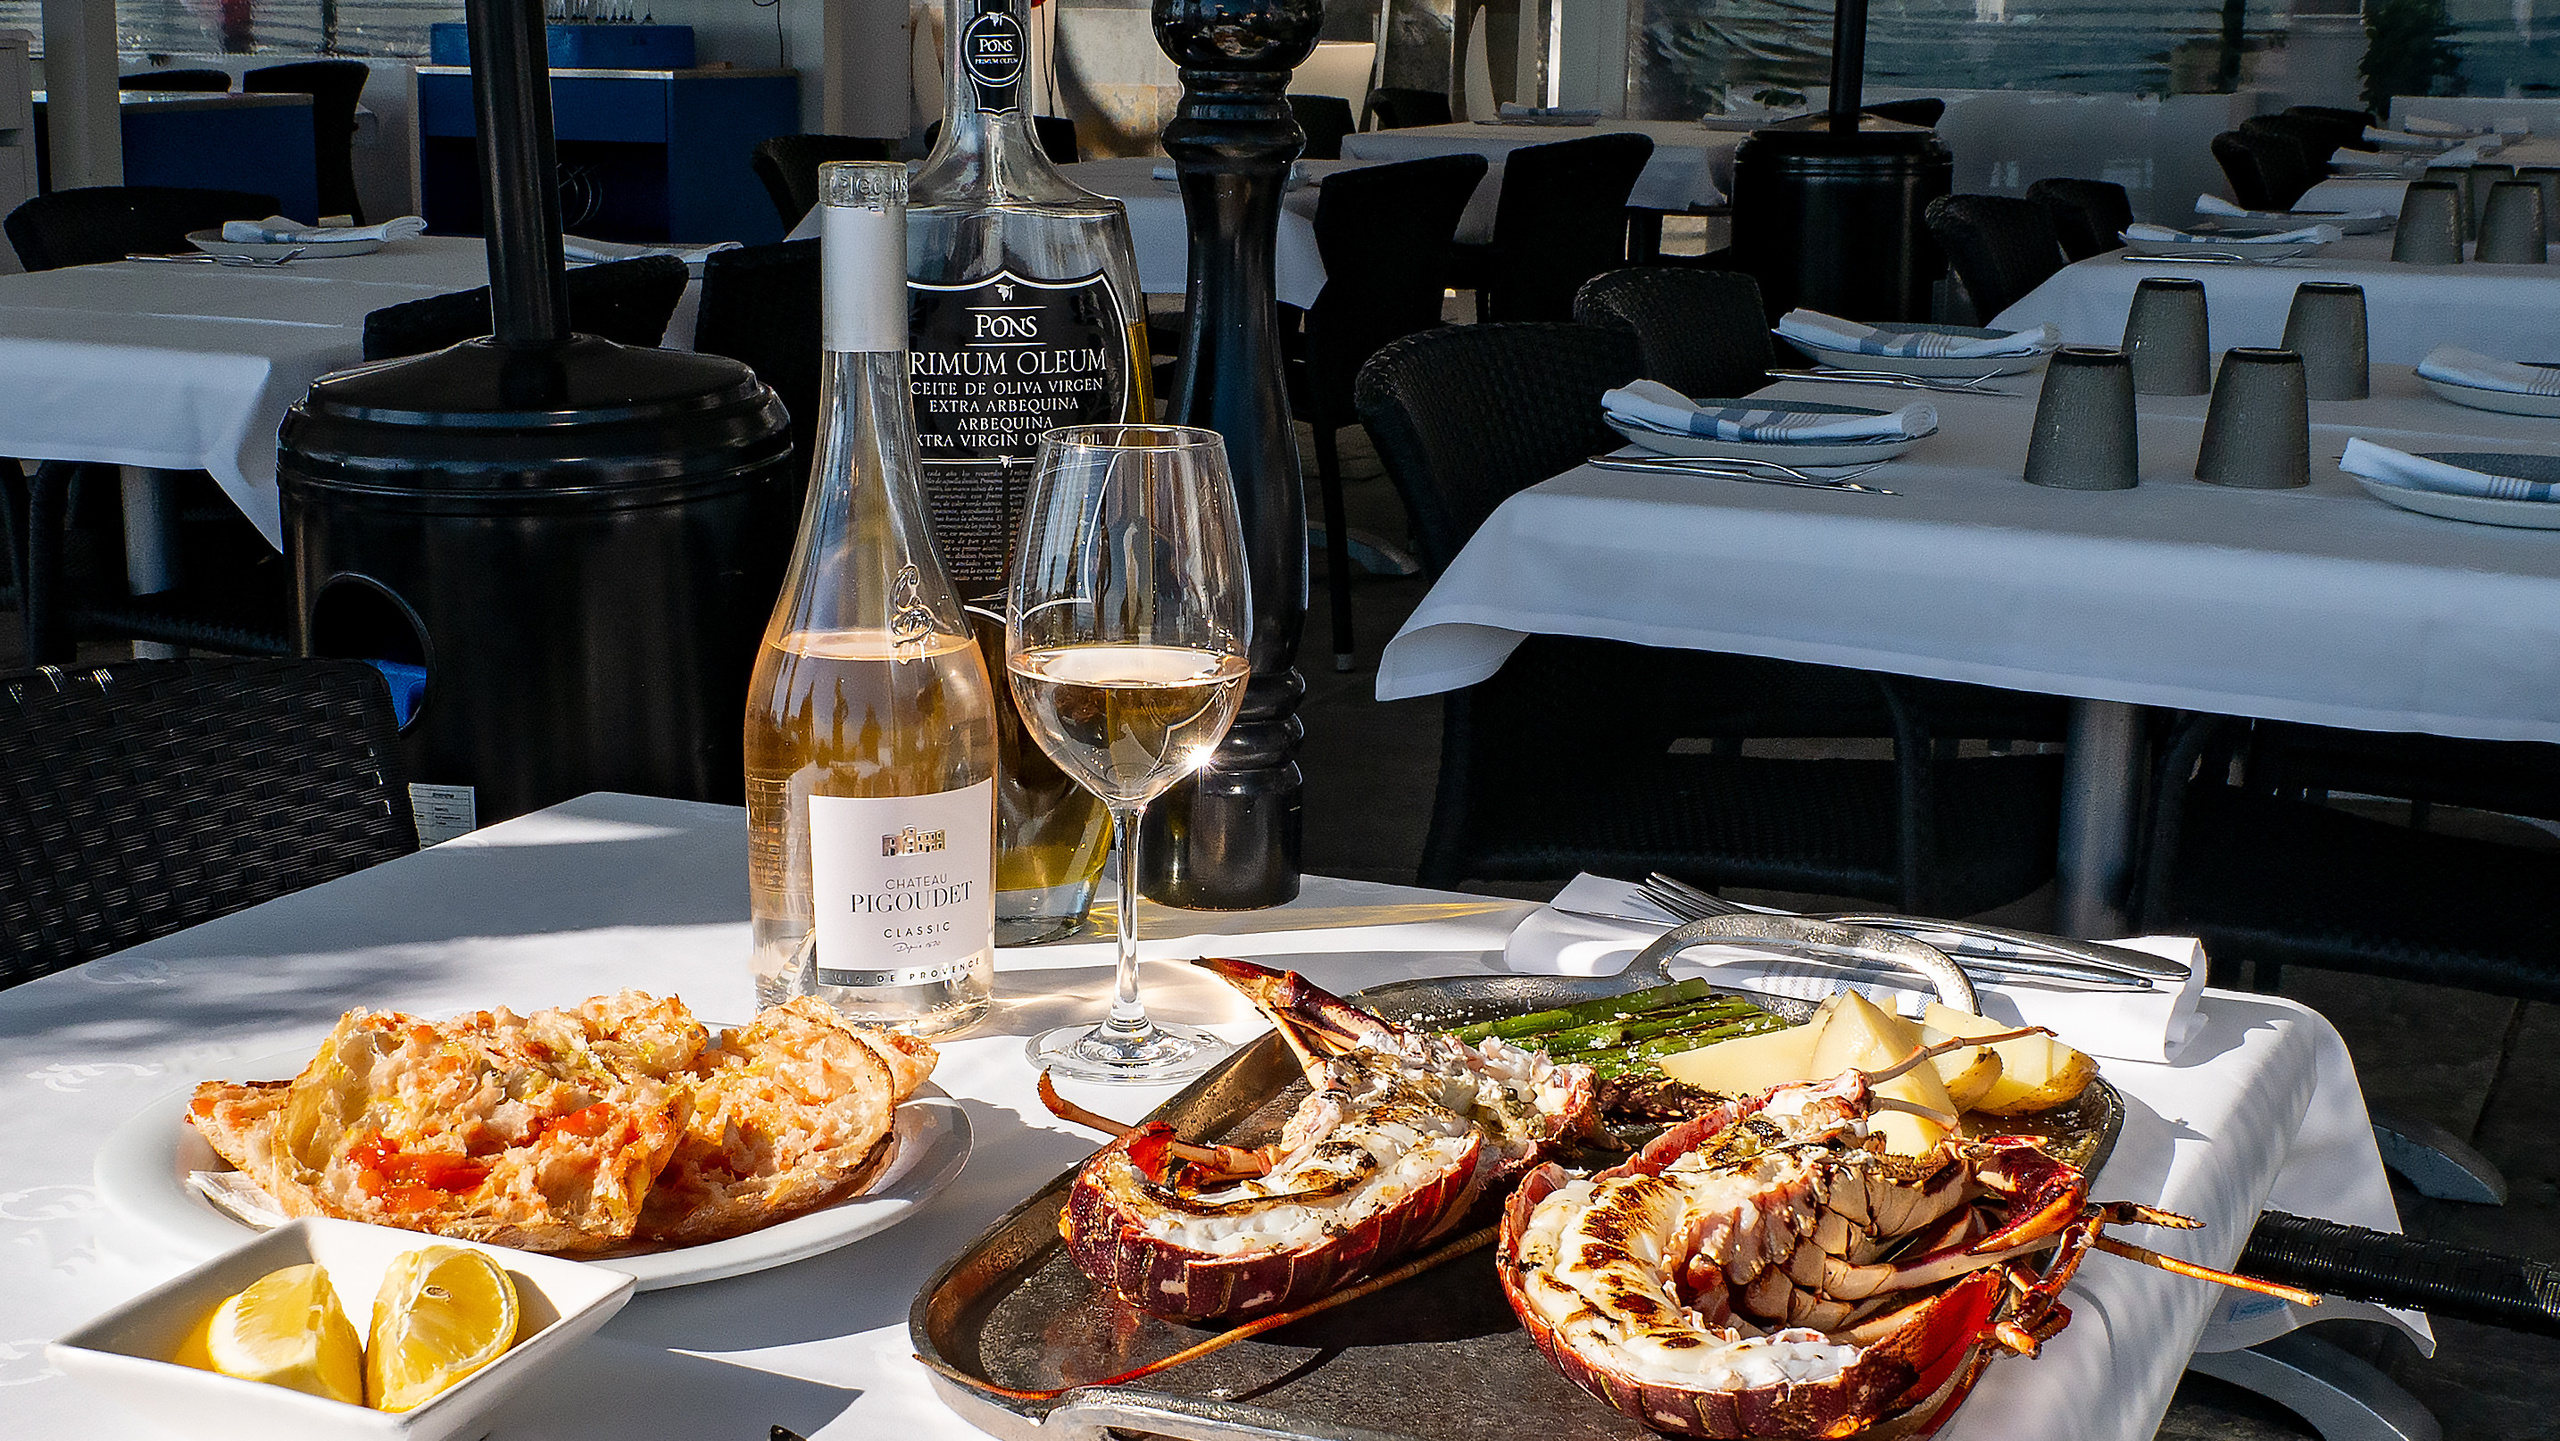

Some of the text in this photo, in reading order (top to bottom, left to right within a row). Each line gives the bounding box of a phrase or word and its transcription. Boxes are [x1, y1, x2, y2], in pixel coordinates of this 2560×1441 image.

[979, 38, 1013, 53] PONS
[974, 314, 1038, 338] PONS
[910, 348, 1107, 376] RIMUM OLEUM
[910, 377, 1103, 396] CEITE DE OLIVA VIRGEN
[929, 397, 1079, 415] EXTRA ARBEQUINA
[957, 416, 1054, 433] ARBEQUINA
[917, 434, 954, 447] XTRA
[959, 433, 1019, 447] VIRGIN
[885, 873, 948, 890] CHATEAU
[852, 881, 973, 913] PIGOUDET
[884, 921, 951, 938] CLASSIC
[877, 974, 895, 983] DE
[909, 957, 980, 981] PROVENCE
